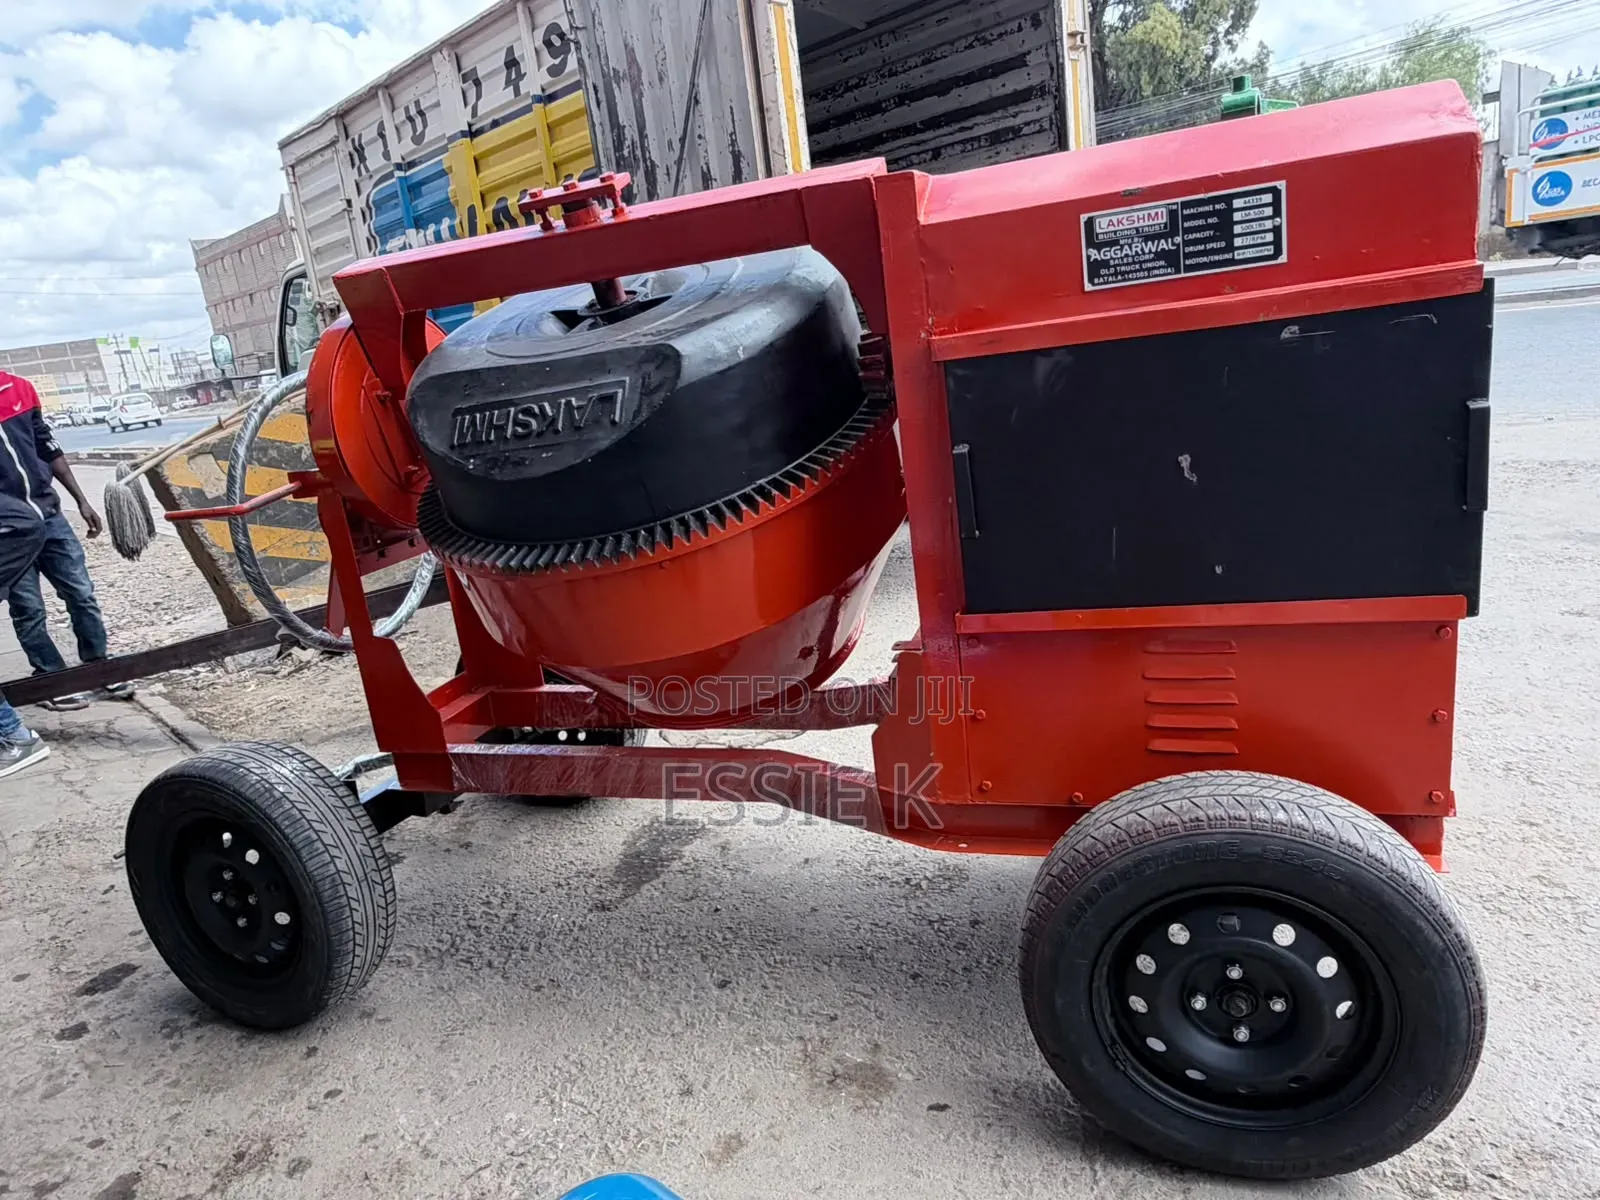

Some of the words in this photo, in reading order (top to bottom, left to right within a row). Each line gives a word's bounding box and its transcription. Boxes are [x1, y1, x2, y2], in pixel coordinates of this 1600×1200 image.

[461, 22, 571, 118] 749
[1581, 178, 1600, 187] BEC
[1183, 204, 1214, 215] MACHINE
[1214, 202, 1228, 210] NO.
[1098, 210, 1164, 230] LAKSHMI
[1183, 218, 1207, 228] MODEL
[1098, 228, 1137, 240] BUILDING
[1139, 224, 1165, 233] TRUST
[1184, 230, 1214, 240] CAPACITY
[1088, 237, 1177, 262] AGGARWAL
[1184, 244, 1205, 253] DRUM
[1206, 241, 1226, 250] SPEED
[1109, 257, 1133, 266] SALES
[1134, 253, 1156, 262] CORP.
[1185, 252, 1233, 265] MOTOR/ENGINE
[1100, 267, 1115, 275] OLD
[1117, 264, 1140, 273] TRUCK
[1150, 267, 1175, 276] (INDIA)
[453, 387, 624, 447] LAKSHMI
